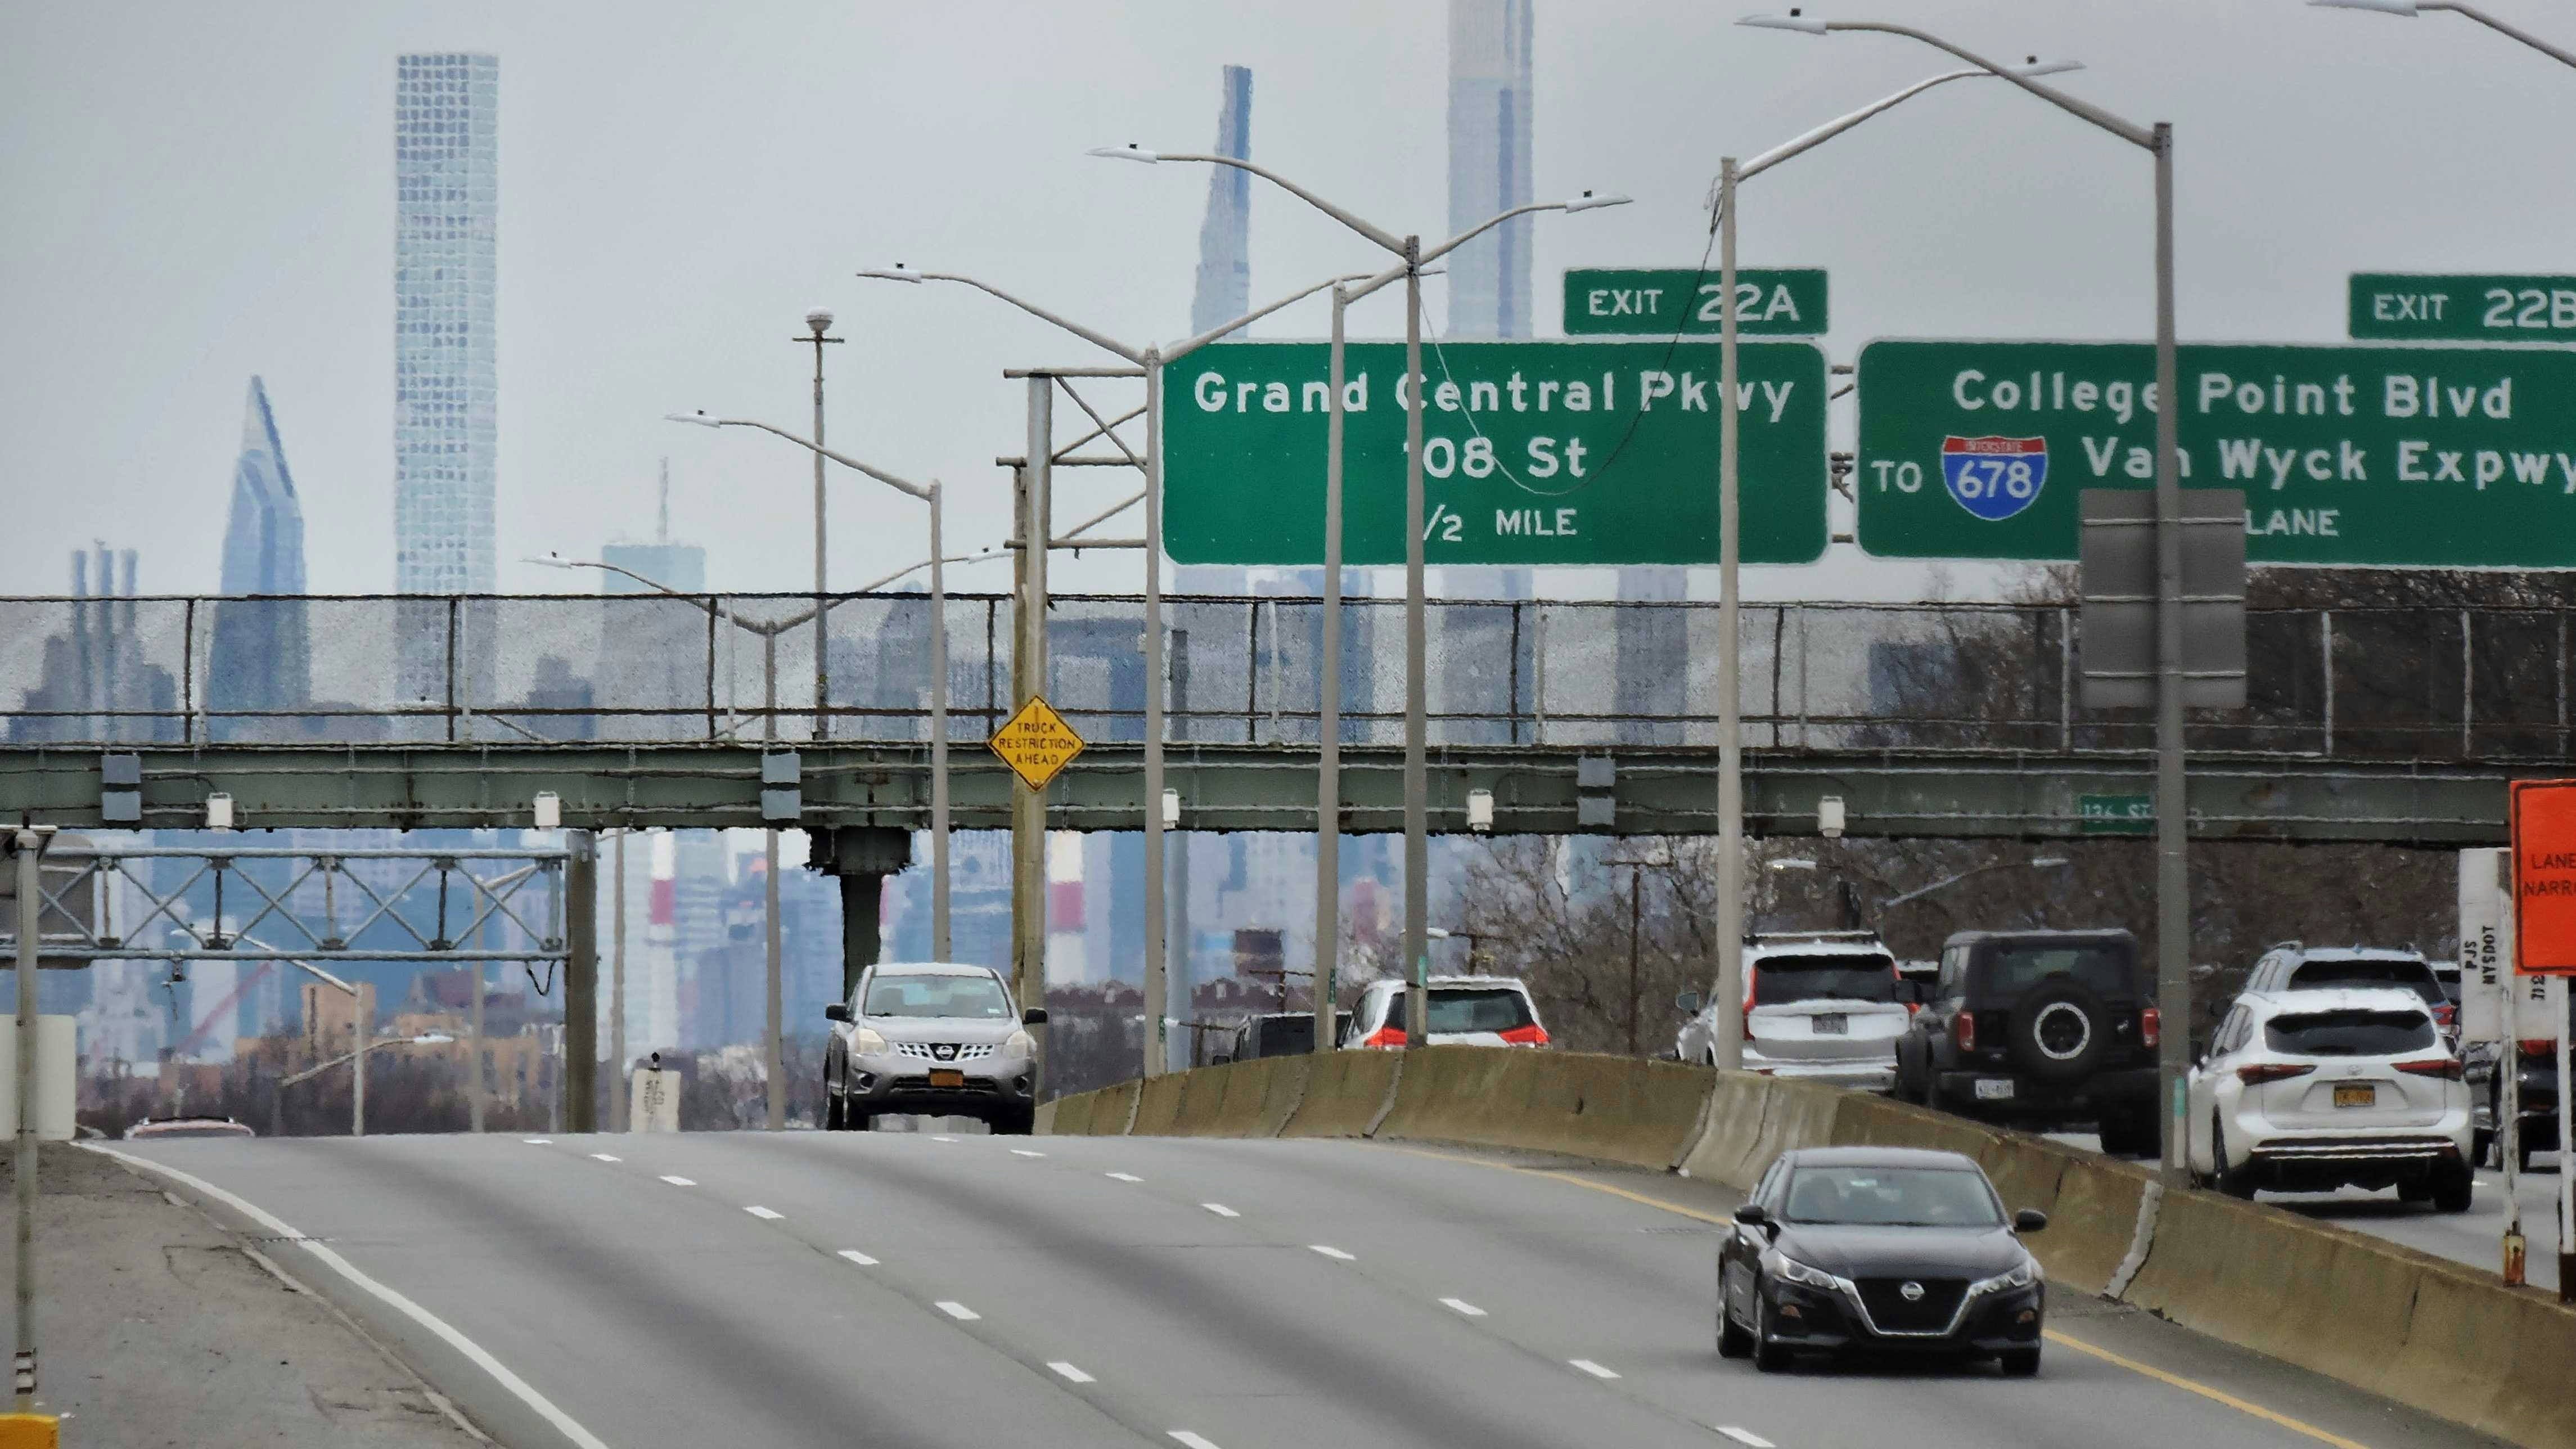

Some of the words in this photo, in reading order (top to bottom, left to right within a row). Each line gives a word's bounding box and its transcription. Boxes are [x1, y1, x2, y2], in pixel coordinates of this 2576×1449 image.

[1588, 289, 1663, 316] EXIT
[1697, 283, 1800, 321] 22A
[2373, 293, 2449, 321] EXIT
[2483, 288, 2576, 328] 22B
[1194, 371, 1368, 413] Grand
[1395, 371, 1614, 412] Central
[1640, 370, 1795, 423] Pkwy
[1953, 368, 2159, 424] College
[2199, 372, 2356, 416] Point
[2385, 374, 2512, 419] Blvd
[1403, 436, 1495, 479] 08
[1527, 436, 1588, 478] St
[1870, 460, 1923, 493] TO
[2218, 438, 2368, 490] Wyck
[1957, 460, 2032, 498] 678
[1423, 504, 1463, 542] /2
[1496, 508, 1578, 536] MILE
[2245, 508, 2340, 536] LANE
[998, 737, 1075, 749] RESTRICTION
[1016, 722, 1056, 734] TRUCK
[1015, 753, 1059, 765] AHEAD
[2523, 880, 2576, 897] NARR
